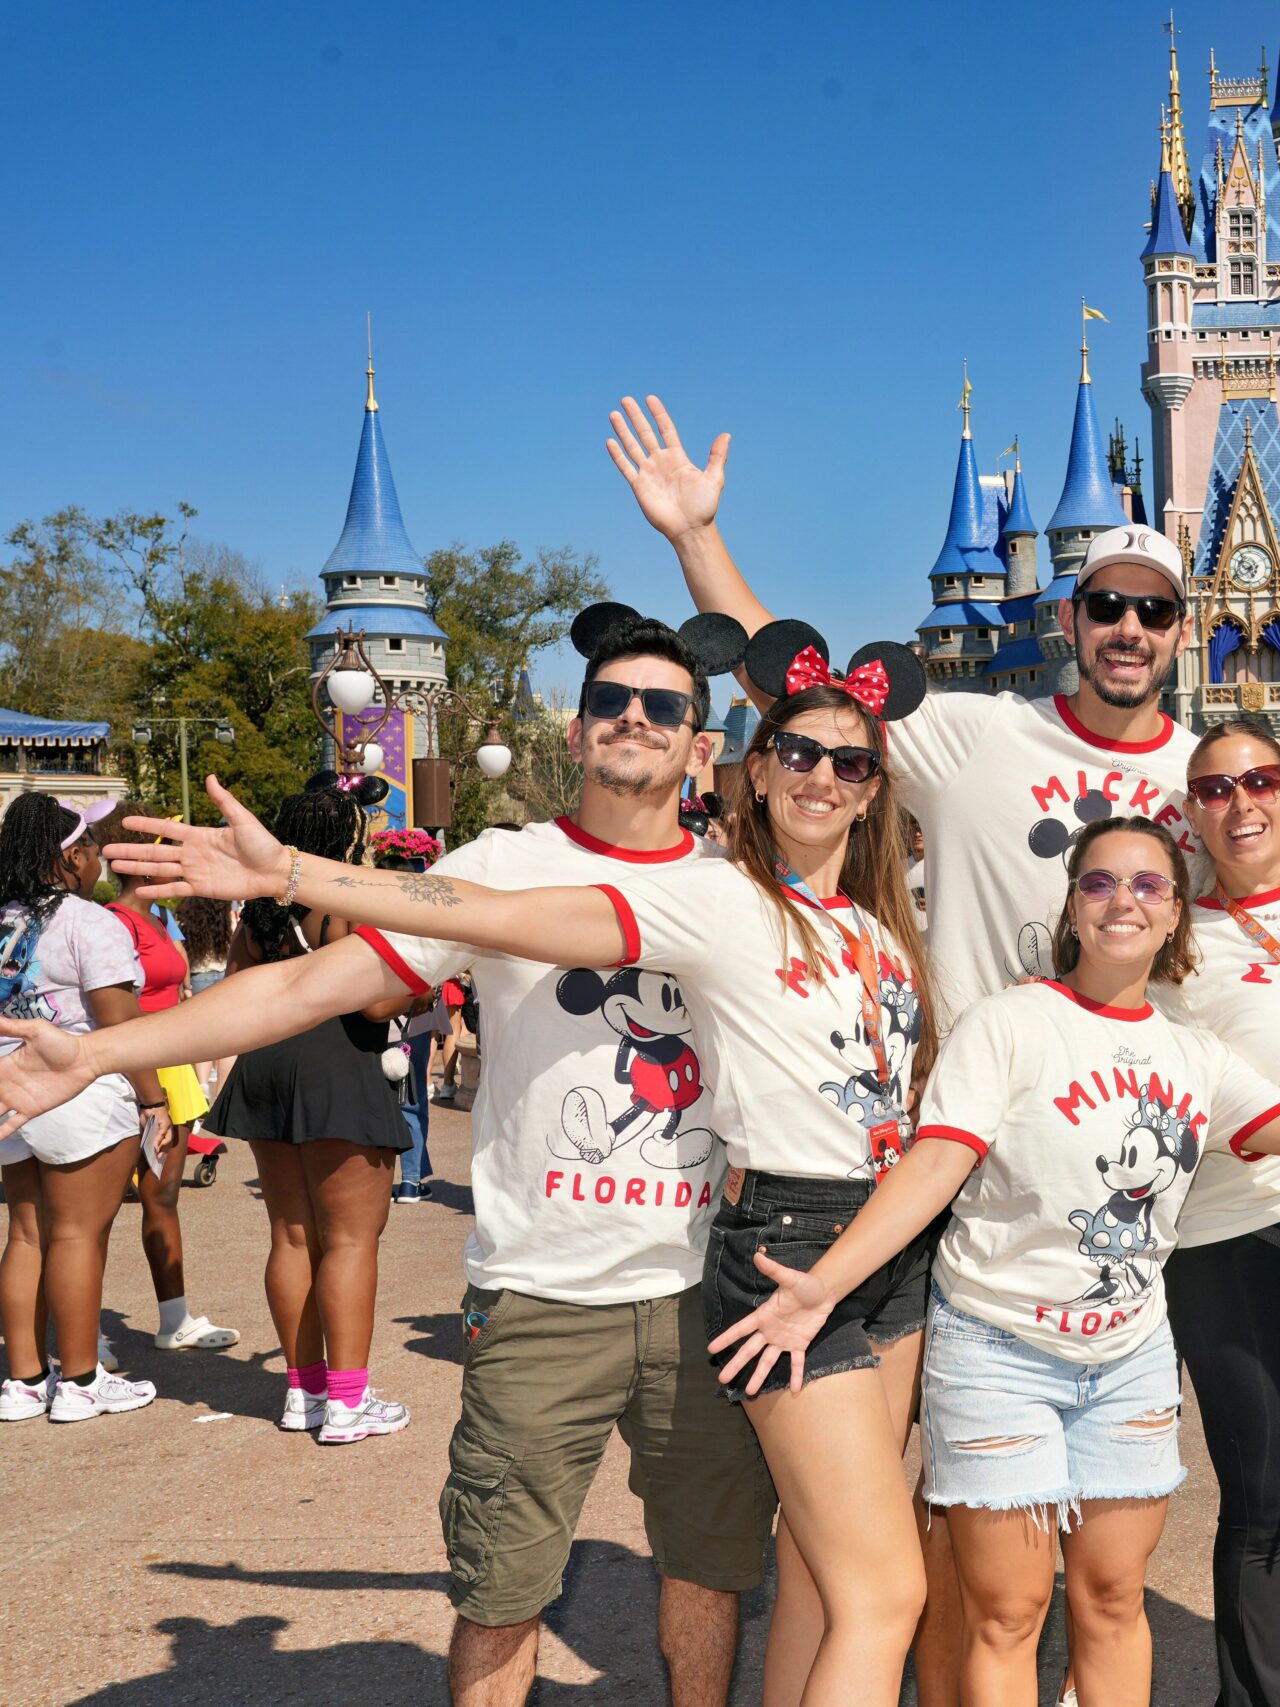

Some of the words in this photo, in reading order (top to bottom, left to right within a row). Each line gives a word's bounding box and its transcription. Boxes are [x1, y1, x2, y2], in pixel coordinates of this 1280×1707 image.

[1031, 770, 1196, 854] MICKEY
[1112, 1053, 1152, 1066] Original
[545, 1170, 711, 1209] FLORIDA
